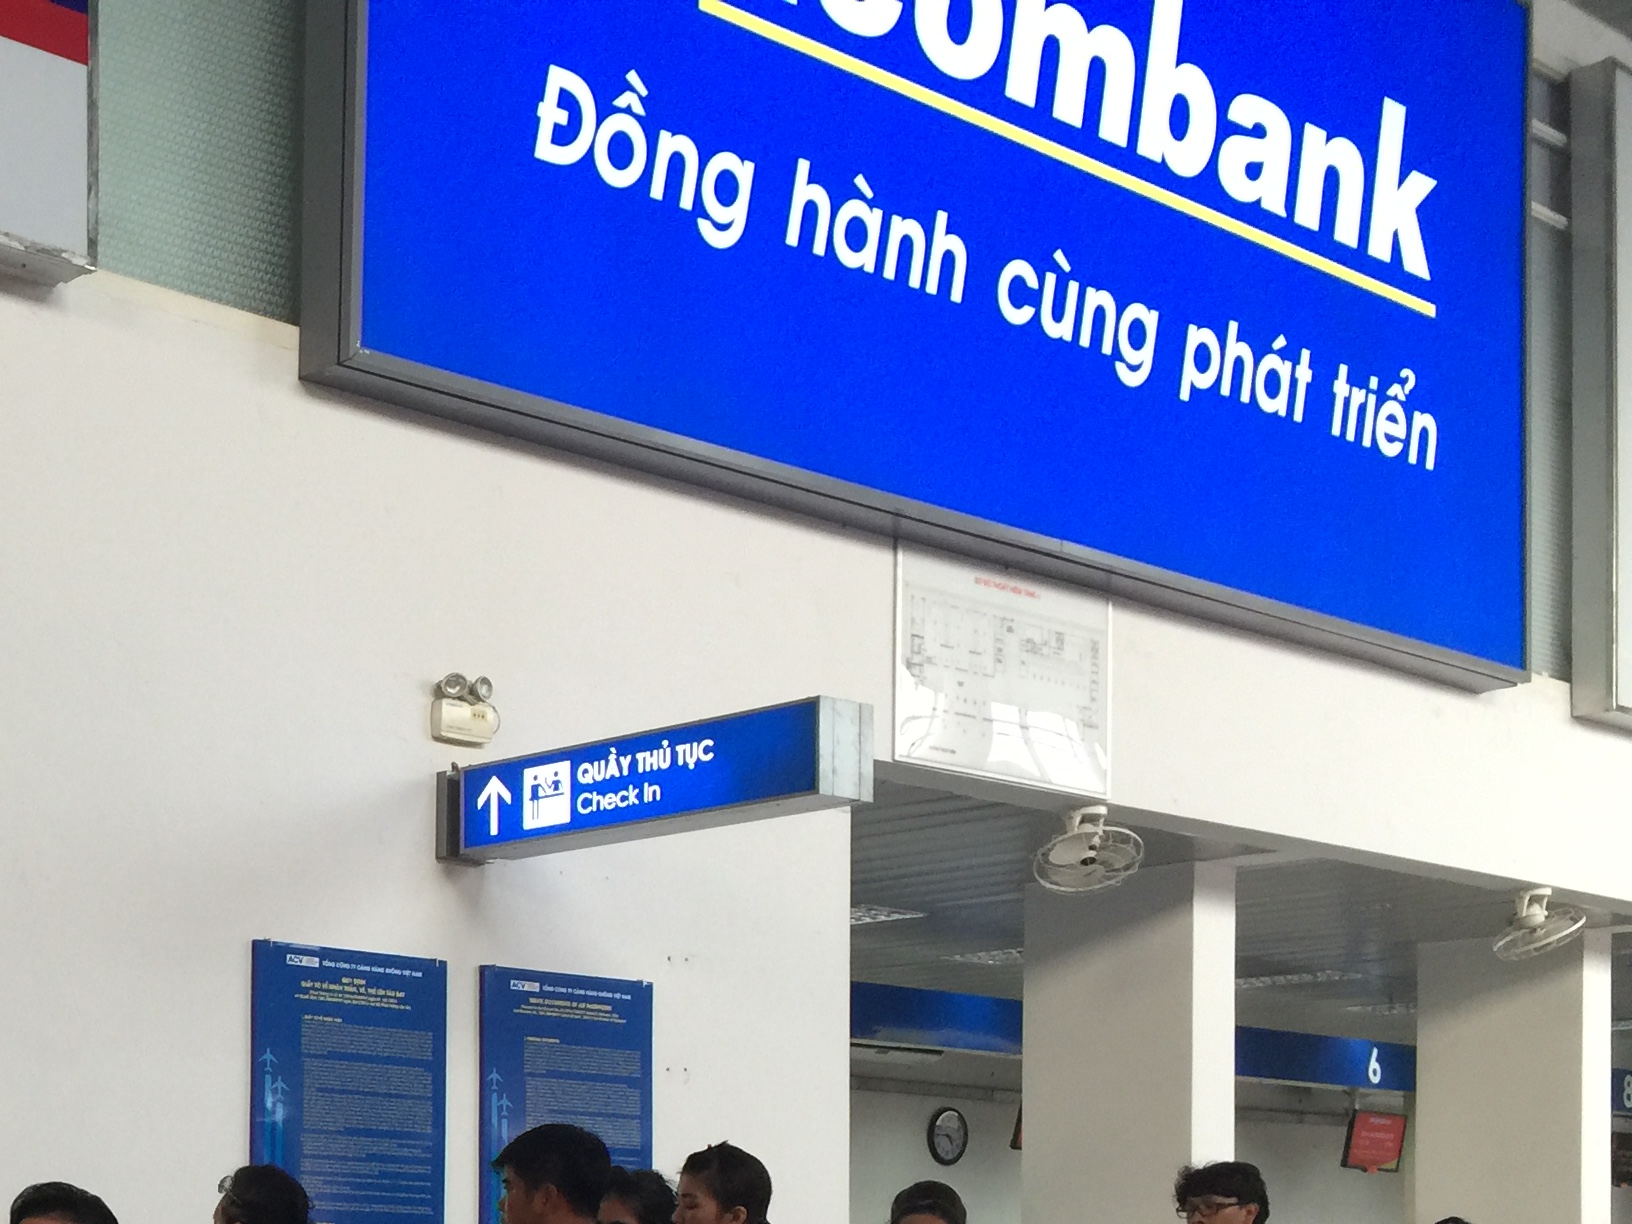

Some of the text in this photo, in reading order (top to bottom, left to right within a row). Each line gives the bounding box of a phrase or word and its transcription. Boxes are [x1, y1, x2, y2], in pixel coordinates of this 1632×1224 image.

[534, 64, 1438, 471] Đồng hành cùng phát triển
[576, 738, 715, 785] QUẦY THỦ TỤC
[576, 782, 661, 815] Check In
[1368, 1046, 1381, 1084] 6
